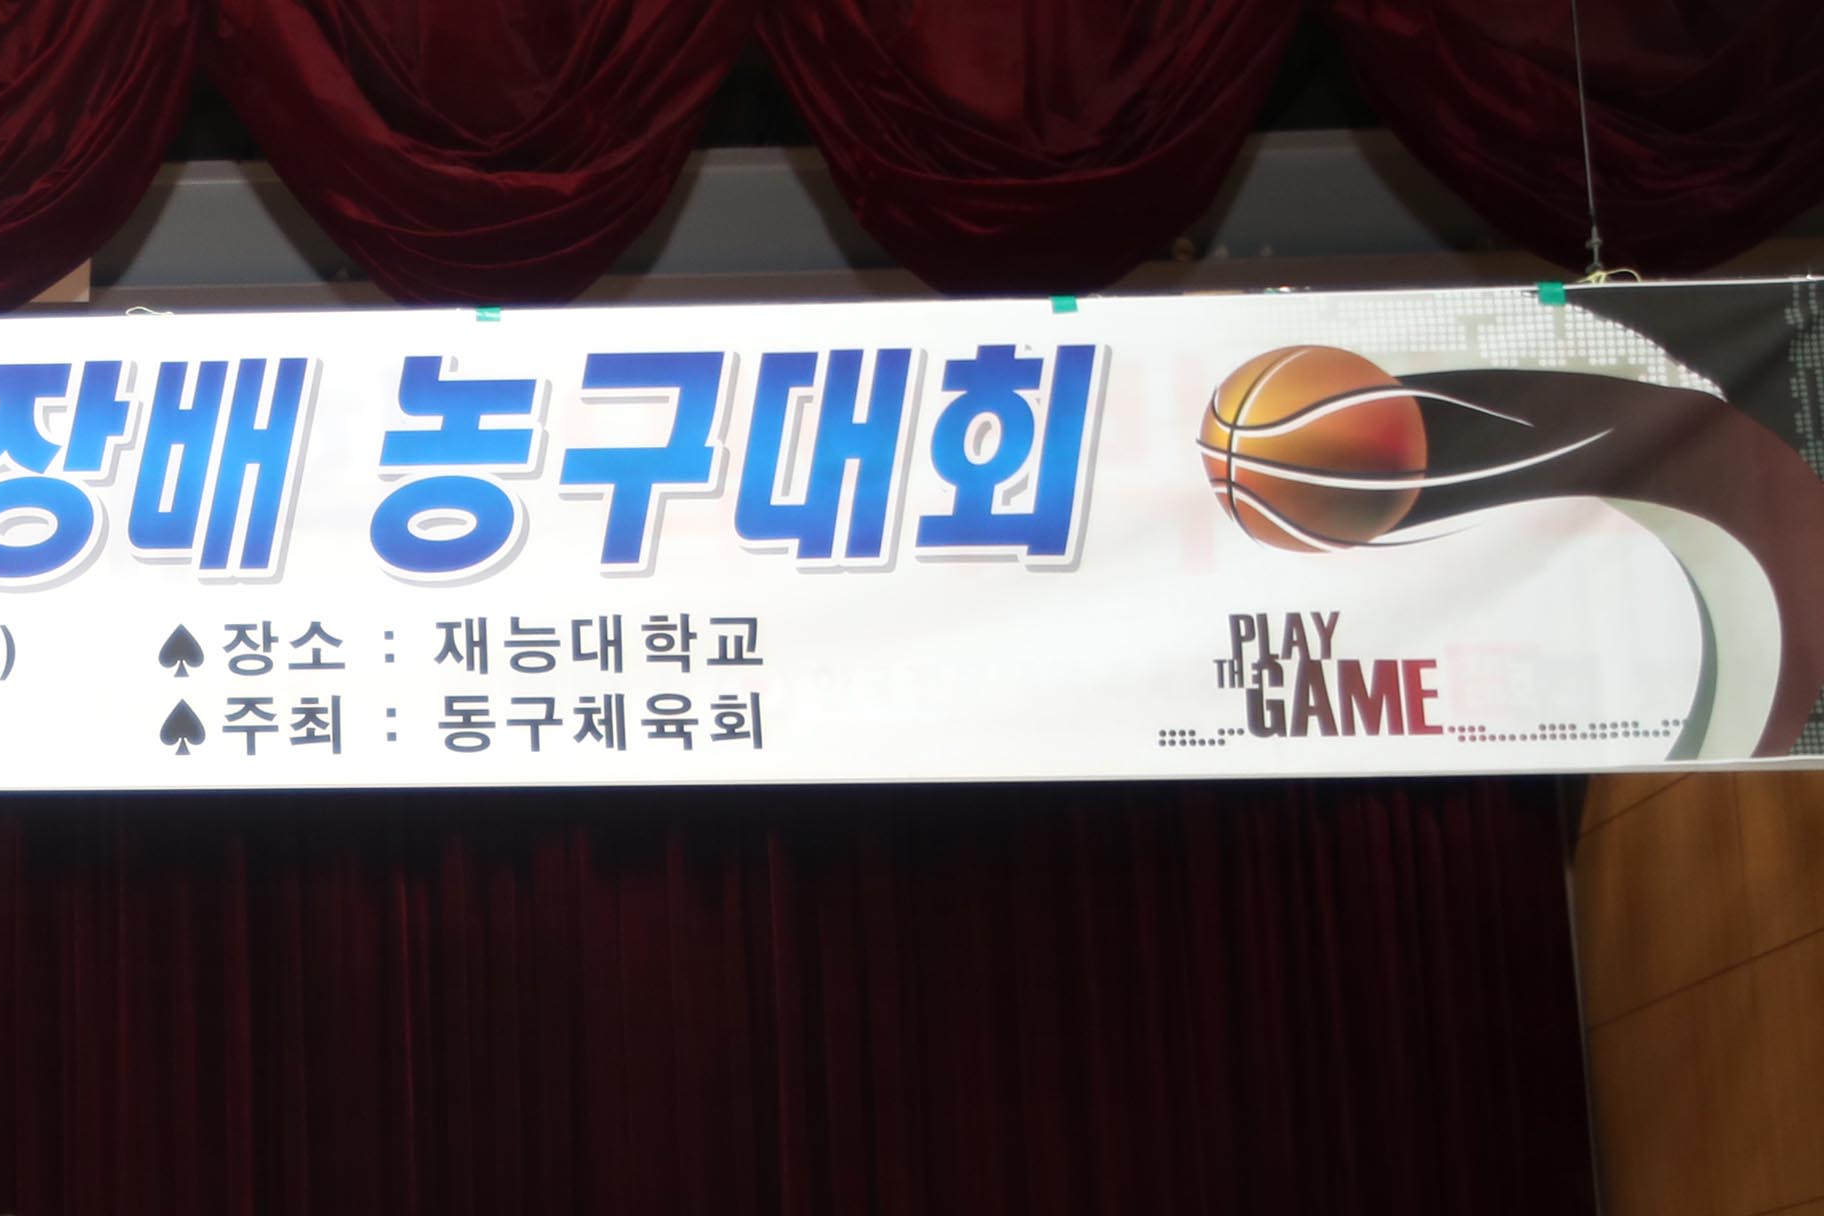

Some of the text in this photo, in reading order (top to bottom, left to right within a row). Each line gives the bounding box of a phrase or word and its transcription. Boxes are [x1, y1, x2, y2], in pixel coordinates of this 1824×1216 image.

[370, 343, 1096, 573] 농구대회
[222, 619, 347, 677] 장소
[433, 612, 765, 675] 재능대학교
[1228, 611, 1341, 662] PLAY
[221, 695, 342, 756] 주최
[437, 690, 764, 753] 동구체육회
[1246, 657, 1444, 738] GAME
